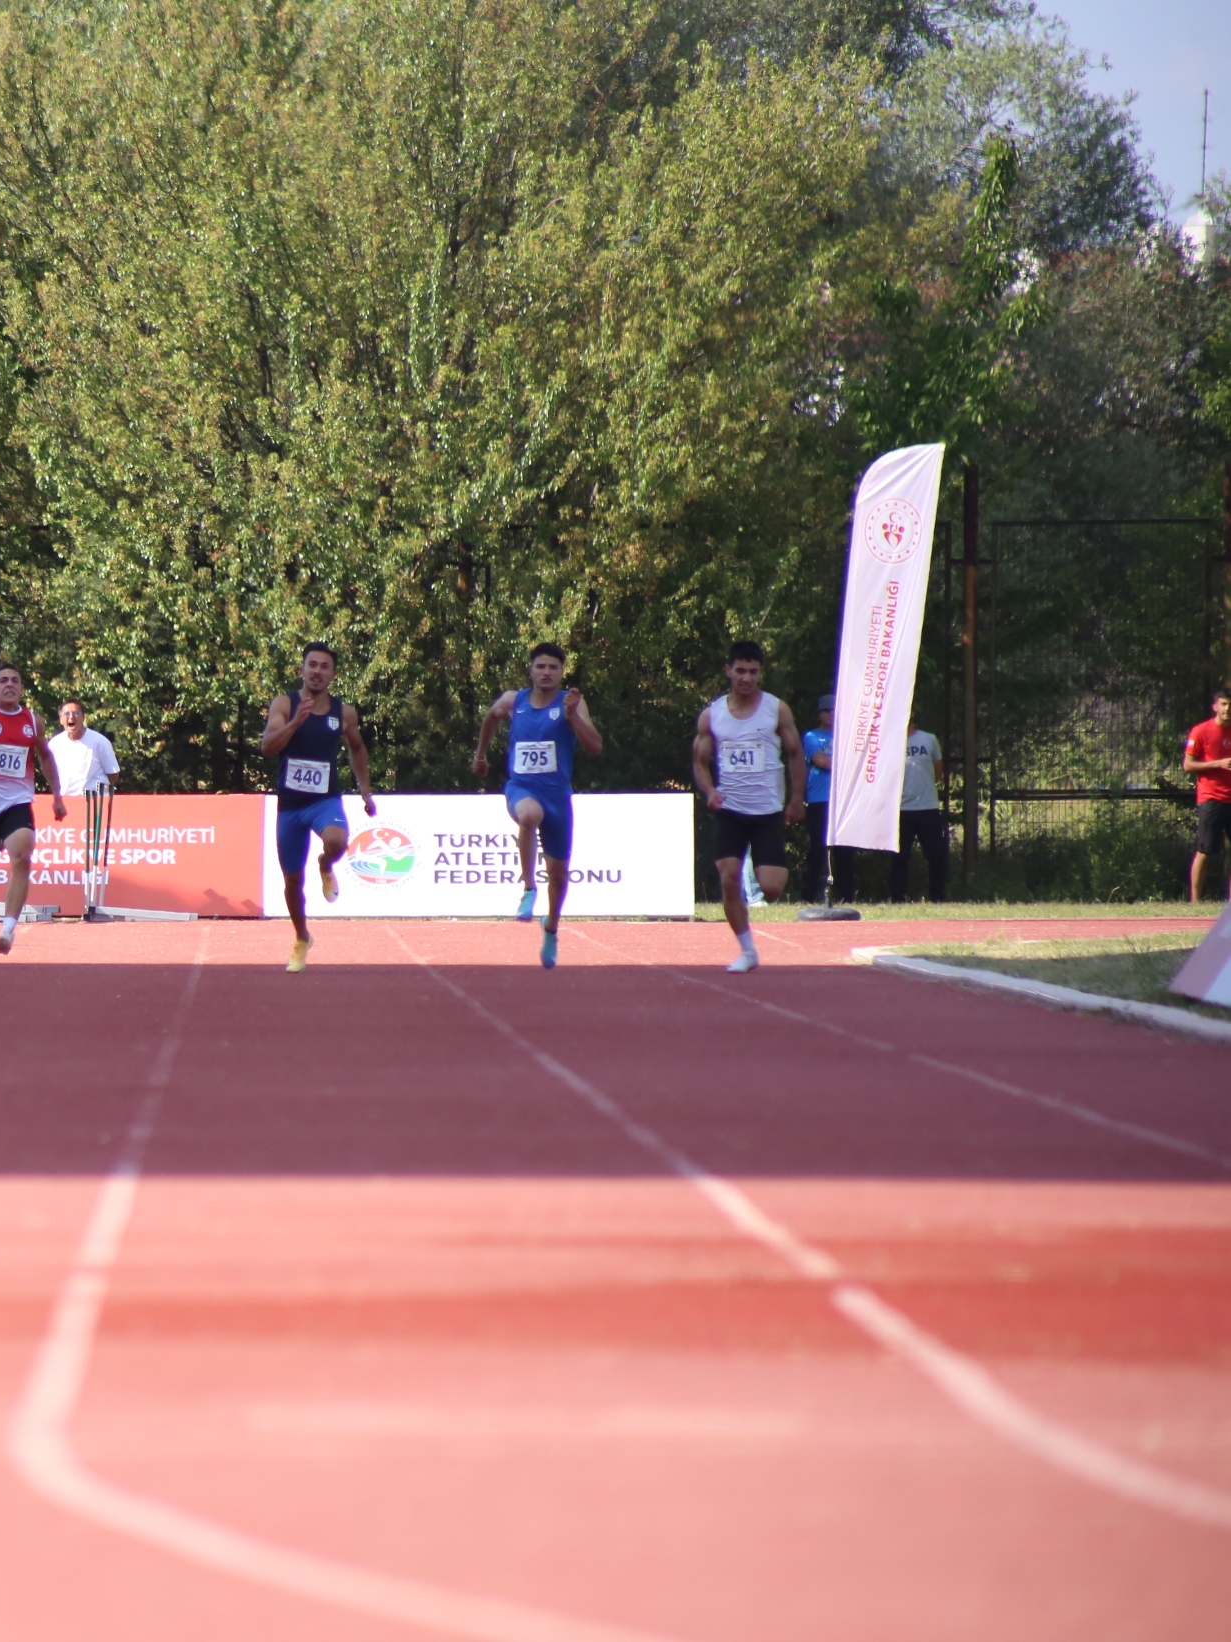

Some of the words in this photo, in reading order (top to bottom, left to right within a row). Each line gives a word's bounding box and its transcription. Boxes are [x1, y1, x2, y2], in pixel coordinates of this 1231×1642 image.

[881, 581, 900, 657] BAKANLIĞI
[854, 700, 871, 754] TÜRKİYE
[863, 605, 882, 696] CUMHURİYETİ
[875, 662, 889, 698] SPOR
[873, 703, 883, 720] VE
[522, 751, 548, 766] 795
[730, 751, 754, 765] 641
[866, 724, 881, 783] GENÇLİK
[293, 768, 322, 785] 440
[35, 825, 75, 843] KİYE
[433, 833, 542, 848] TÜRKİY
[120, 848, 176, 865] SPOR
[434, 852, 545, 866] ATLETİ
[434, 869, 622, 884] FEDERSONU
